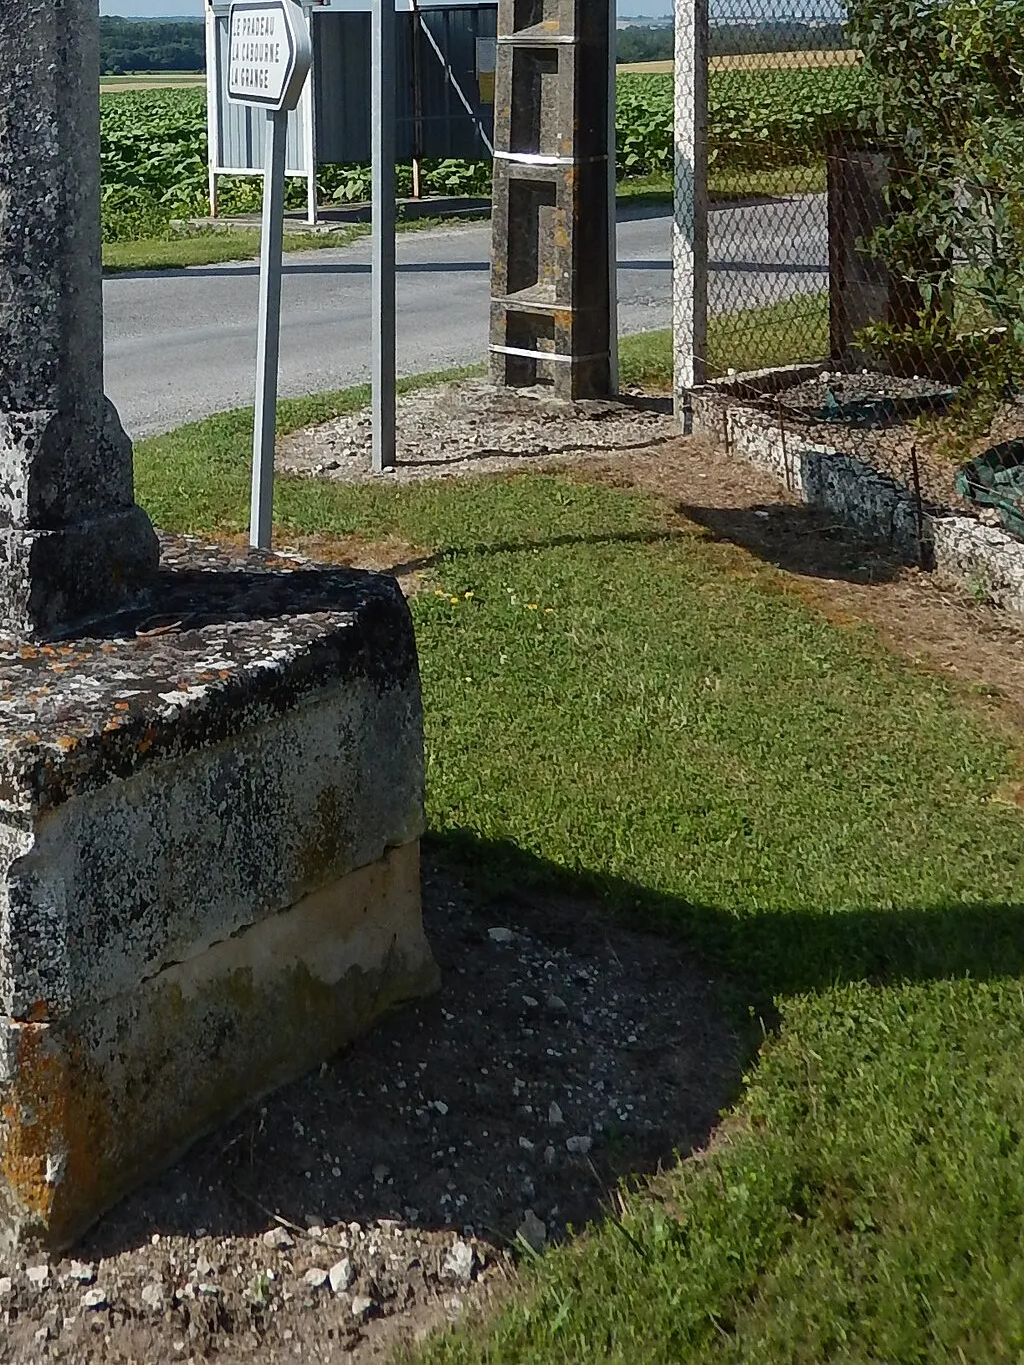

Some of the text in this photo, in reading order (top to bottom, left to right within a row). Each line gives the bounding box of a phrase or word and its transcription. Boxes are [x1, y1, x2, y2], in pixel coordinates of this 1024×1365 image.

[233, 17, 275, 37] LE PRADEAU
[232, 43, 239, 61] LA
[231, 68, 268, 89] LA GRANGE
